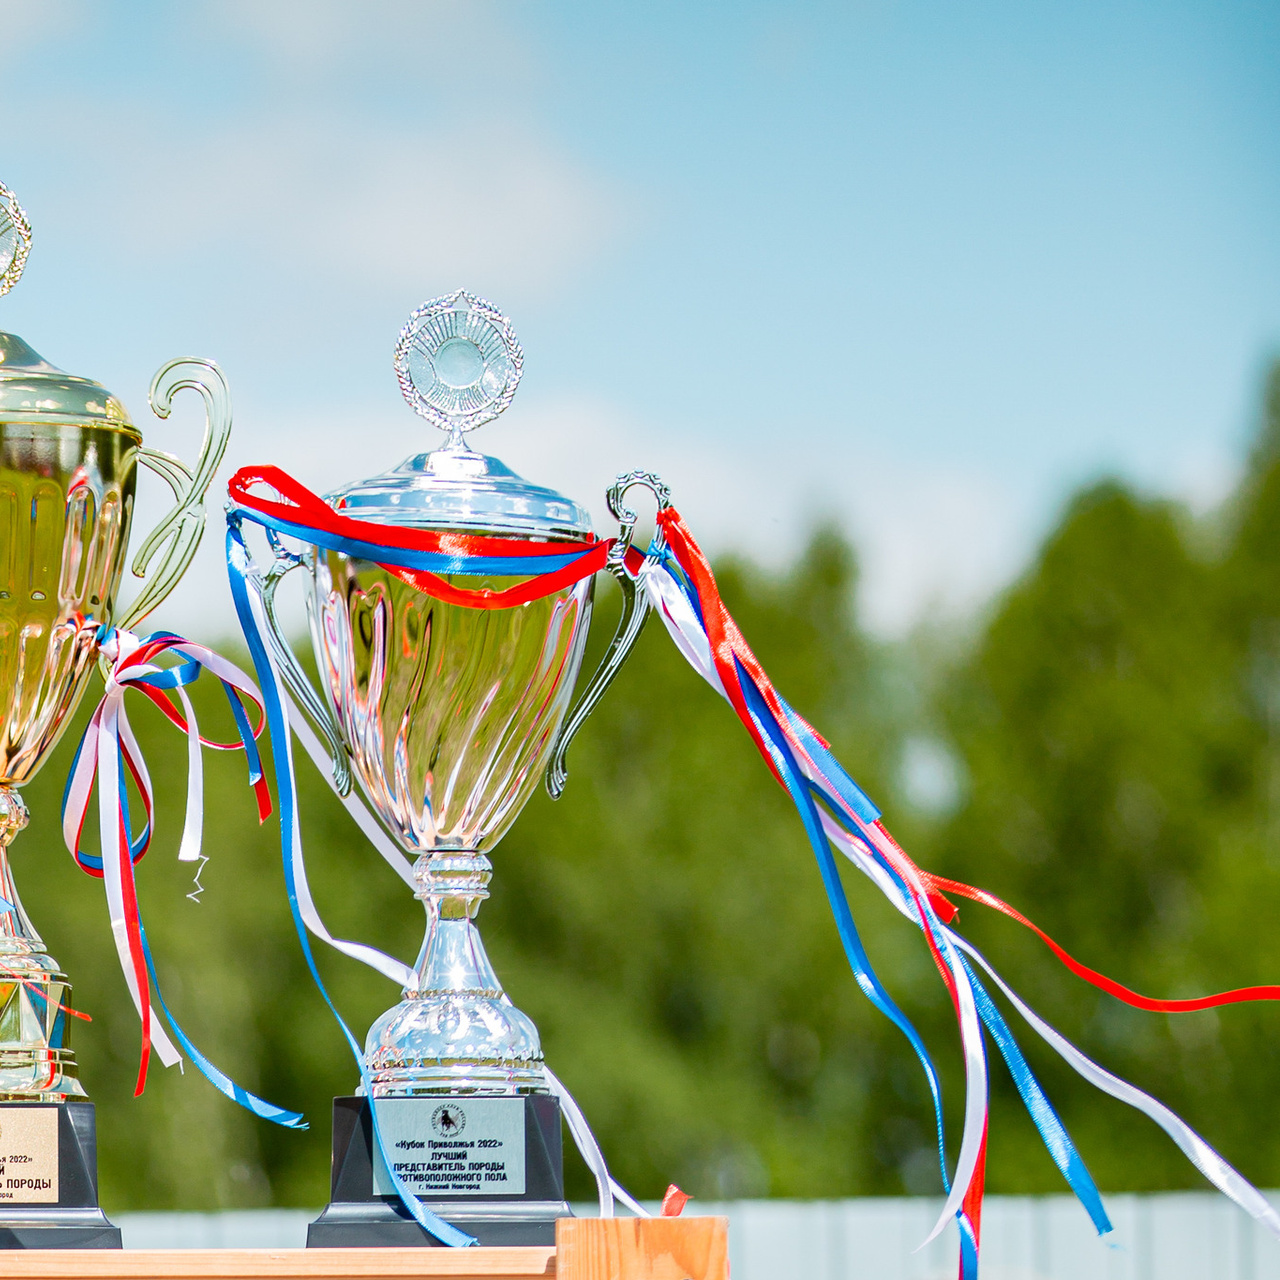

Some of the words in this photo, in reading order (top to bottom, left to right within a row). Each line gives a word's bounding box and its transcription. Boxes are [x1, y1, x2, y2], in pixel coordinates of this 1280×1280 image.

[395, 1140, 425, 1150] «Кубок
[428, 1140, 475, 1149] Приволжья
[477, 1139, 503, 1148] 2022»
[9, 1155, 33, 1164] 2022»
[431, 1150, 467, 1160] ЛУЧШИЙ
[394, 1163, 465, 1172] ПРЕДСТАВИТЕЛЬ
[469, 1162, 505, 1172] ПОРОДЫ
[396, 1173, 482, 1182] РОТИВОПОЛОЖНОГО
[485, 1173, 507, 1181] ПОЛА
[6, 1178, 52, 1190] ПОРОДЫ
